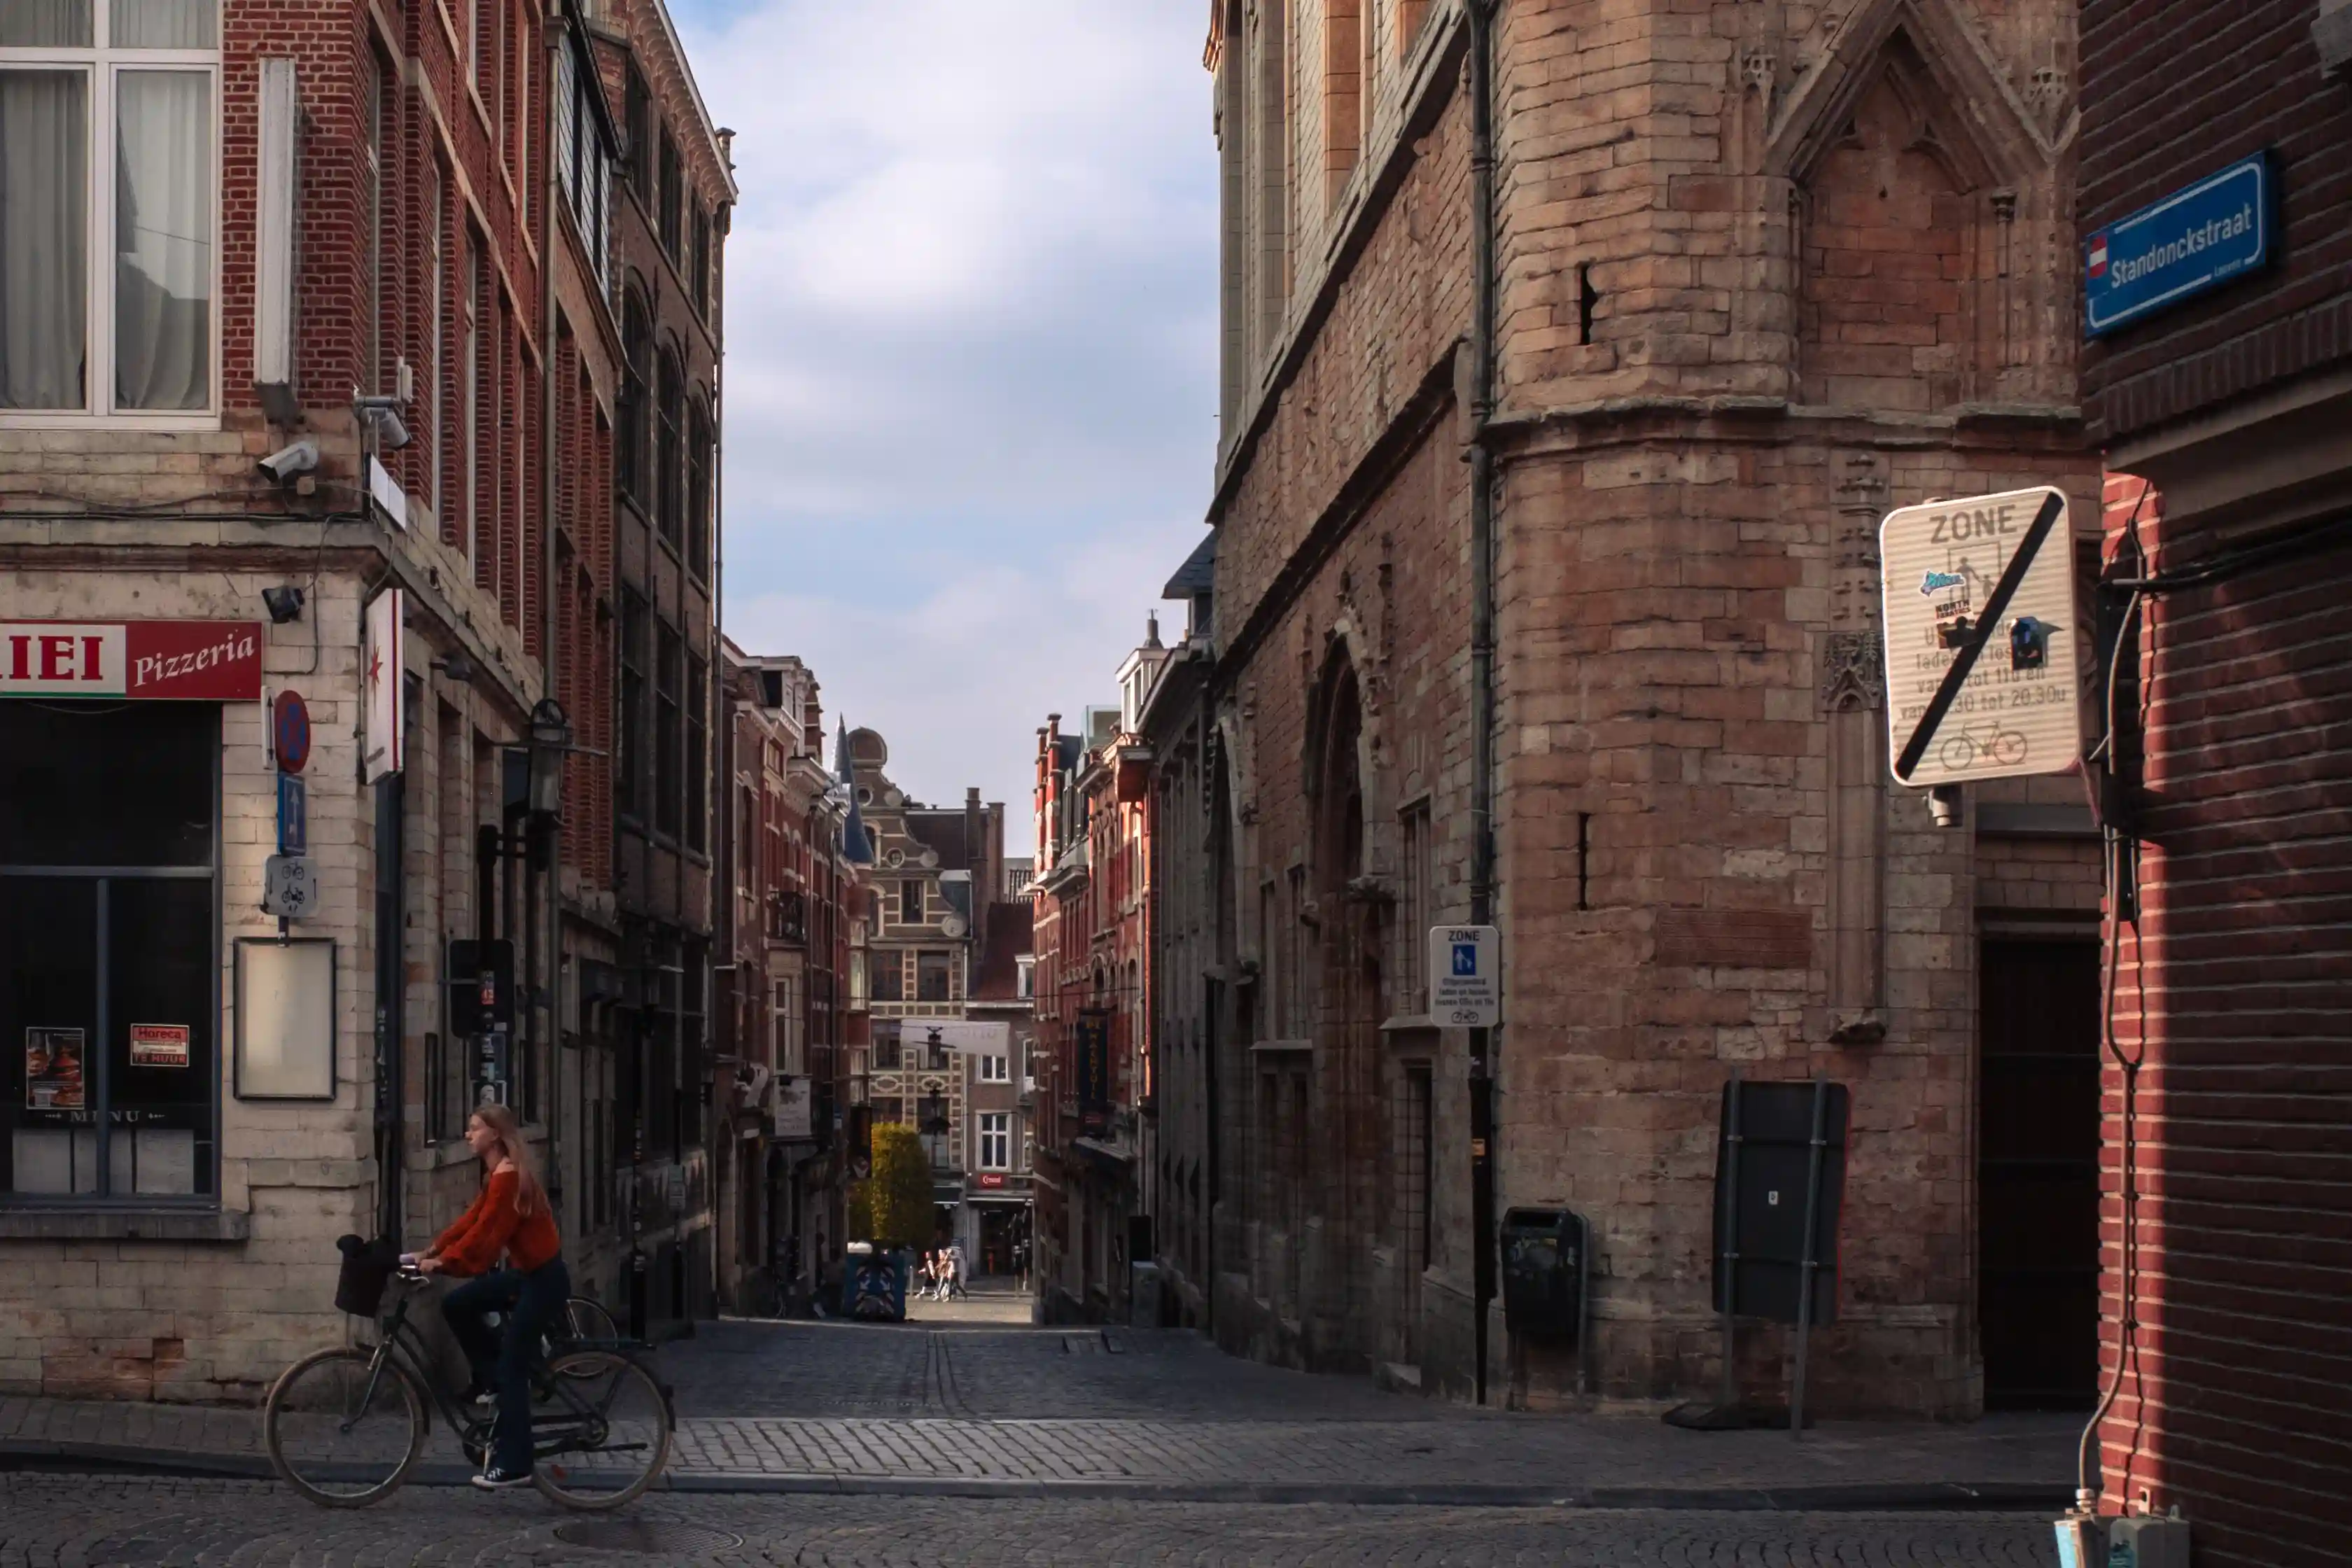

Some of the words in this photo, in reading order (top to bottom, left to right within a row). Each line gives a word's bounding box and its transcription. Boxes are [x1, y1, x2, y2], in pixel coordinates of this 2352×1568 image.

[2111, 201, 2253, 288] Standonckstraat
[1929, 504, 2017, 544] ZONE
[0, 635, 104, 680] IEI
[133, 632, 255, 687] Pizzeria
[1917, 651, 1956, 670] lade
[1448, 930, 1480, 942] ZONE
[139, 1028, 181, 1040] Horeca
[151, 1054, 186, 1063] HUUR
